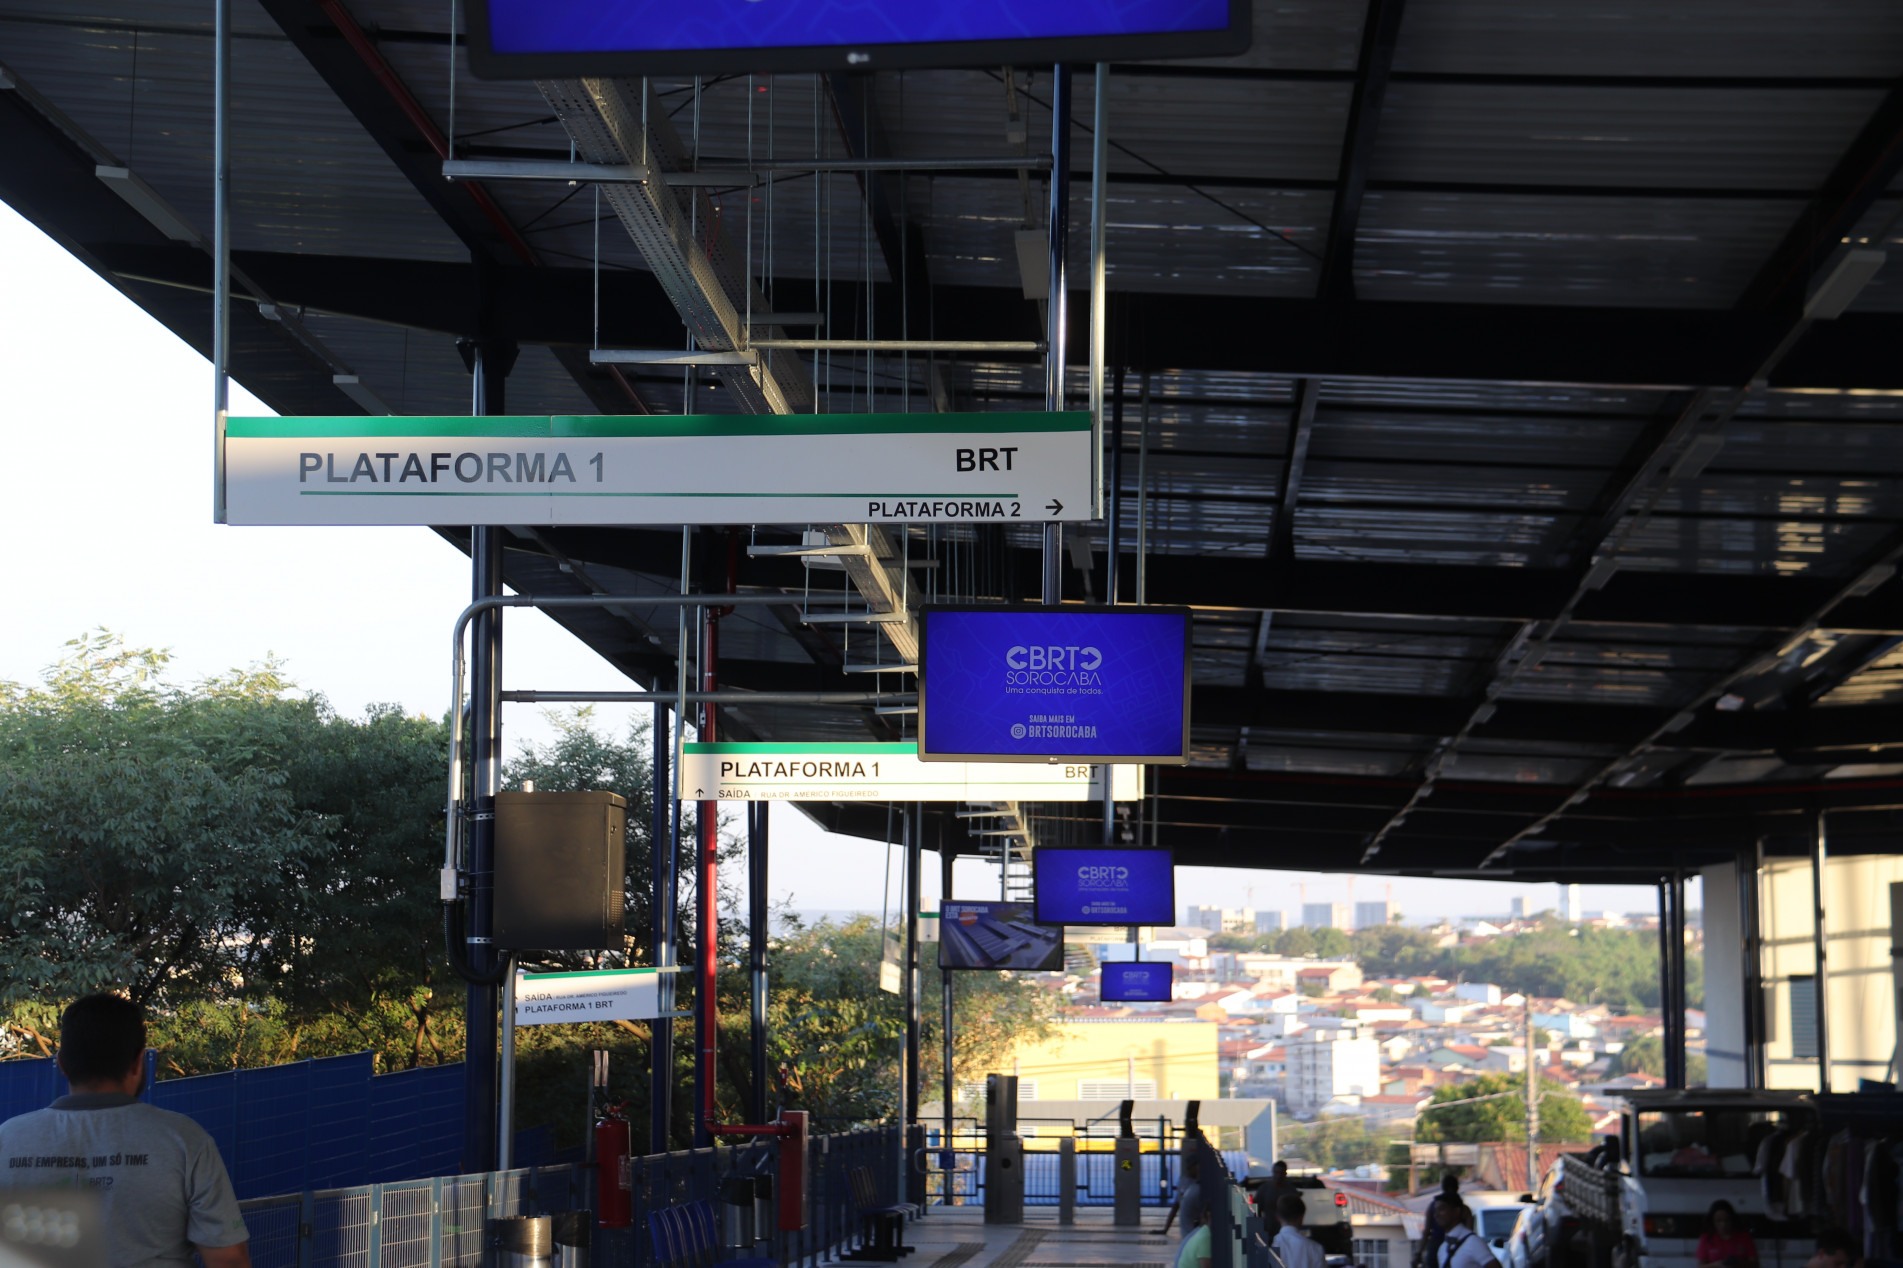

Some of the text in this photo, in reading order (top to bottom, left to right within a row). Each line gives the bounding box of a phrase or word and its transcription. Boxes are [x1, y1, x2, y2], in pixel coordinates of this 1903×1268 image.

[955, 447, 1018, 473] BRT
[299, 451, 604, 484] PLATAFORMA 1
[868, 499, 1021, 519] PLATAFORMA 2
[1006, 671, 1102, 686] SOROCABA
[1005, 686, 1104, 695] Uma conquista de todos.
[1029, 715, 1075, 724] SAIBA MAIS EM
[1029, 726, 1097, 738] BRTSOROCABA
[720, 761, 880, 779] PLATAFORMA 1
[1065, 765, 1098, 779] BRT
[718, 787, 751, 799] SAÍDA
[831, 790, 879, 798] FIGUEIREDO
[1077, 878, 1128, 887] SOROCABA
[525, 992, 552, 1001] SAÍDA
[525, 1002, 586, 1013] PLATAFORMA
[595, 1000, 613, 1009] BRT
[9, 1152, 150, 1169] DUAS EMPRESAS, UM SÓ TIME
